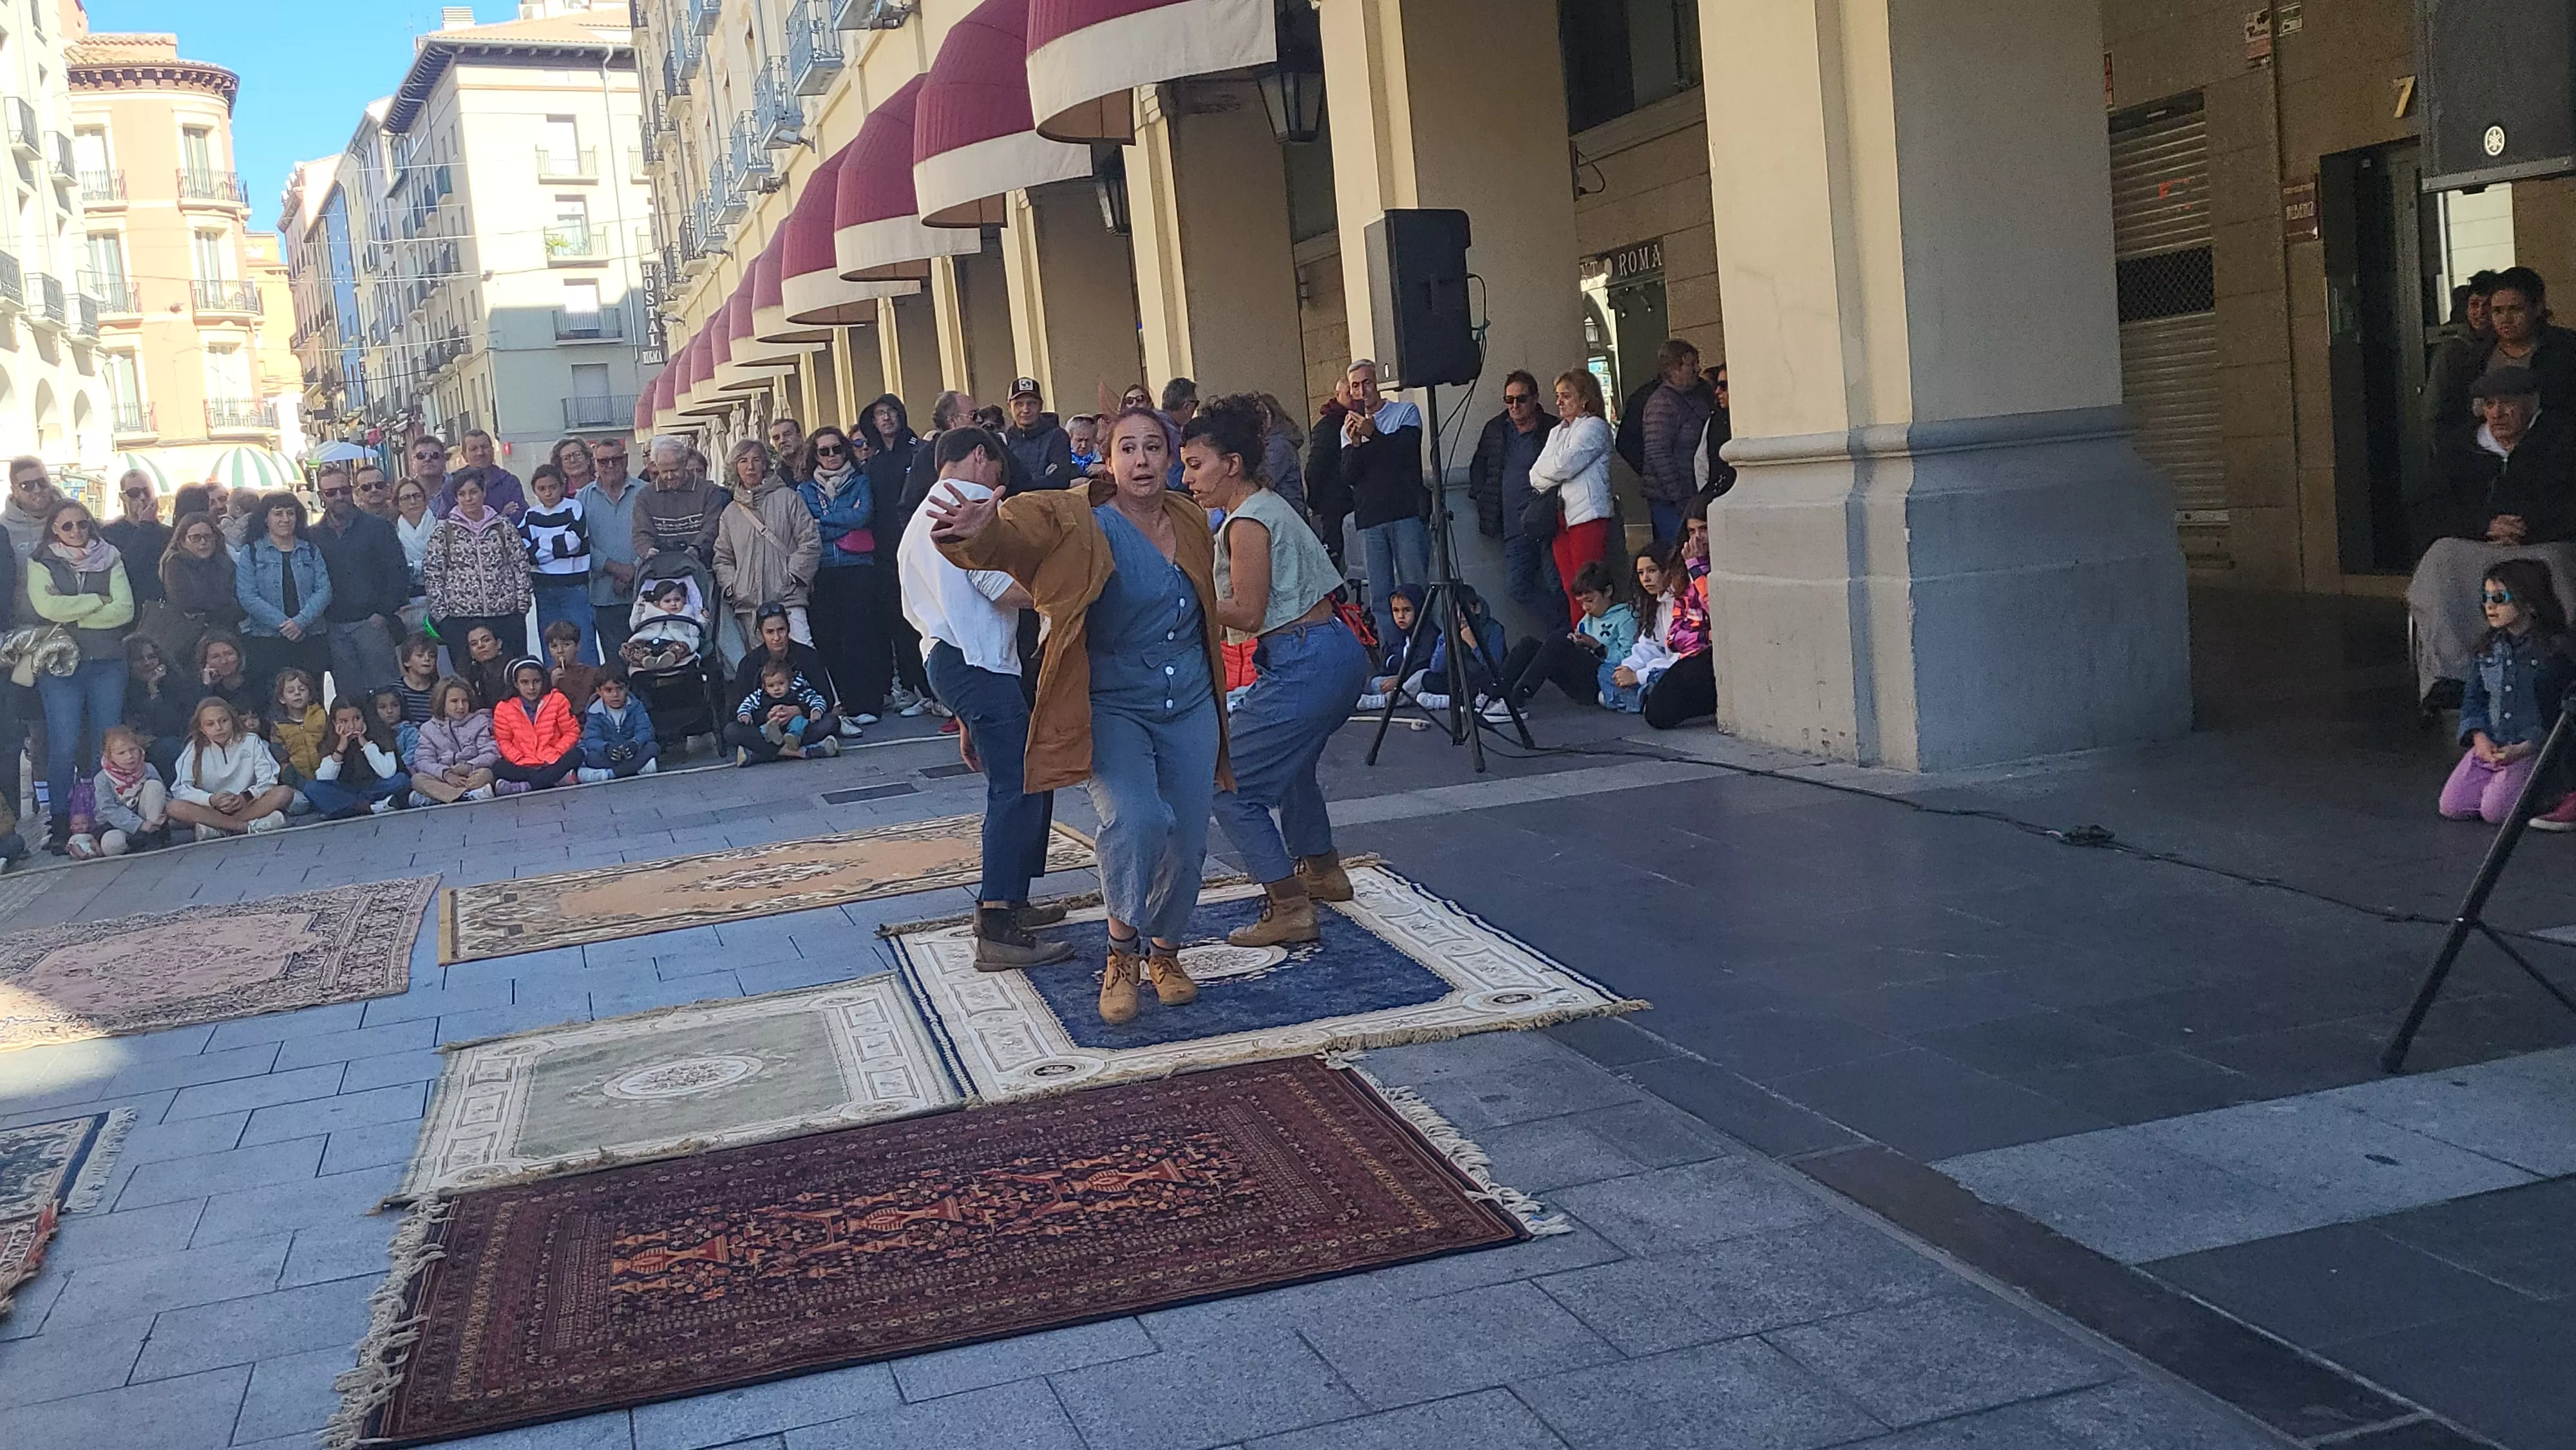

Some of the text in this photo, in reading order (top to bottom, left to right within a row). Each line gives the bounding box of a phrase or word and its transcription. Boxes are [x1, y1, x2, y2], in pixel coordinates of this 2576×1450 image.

[2393, 75, 2416, 118] 7
[1618, 244, 1662, 276] ROMA
[642, 264, 659, 346] HOSTAL
